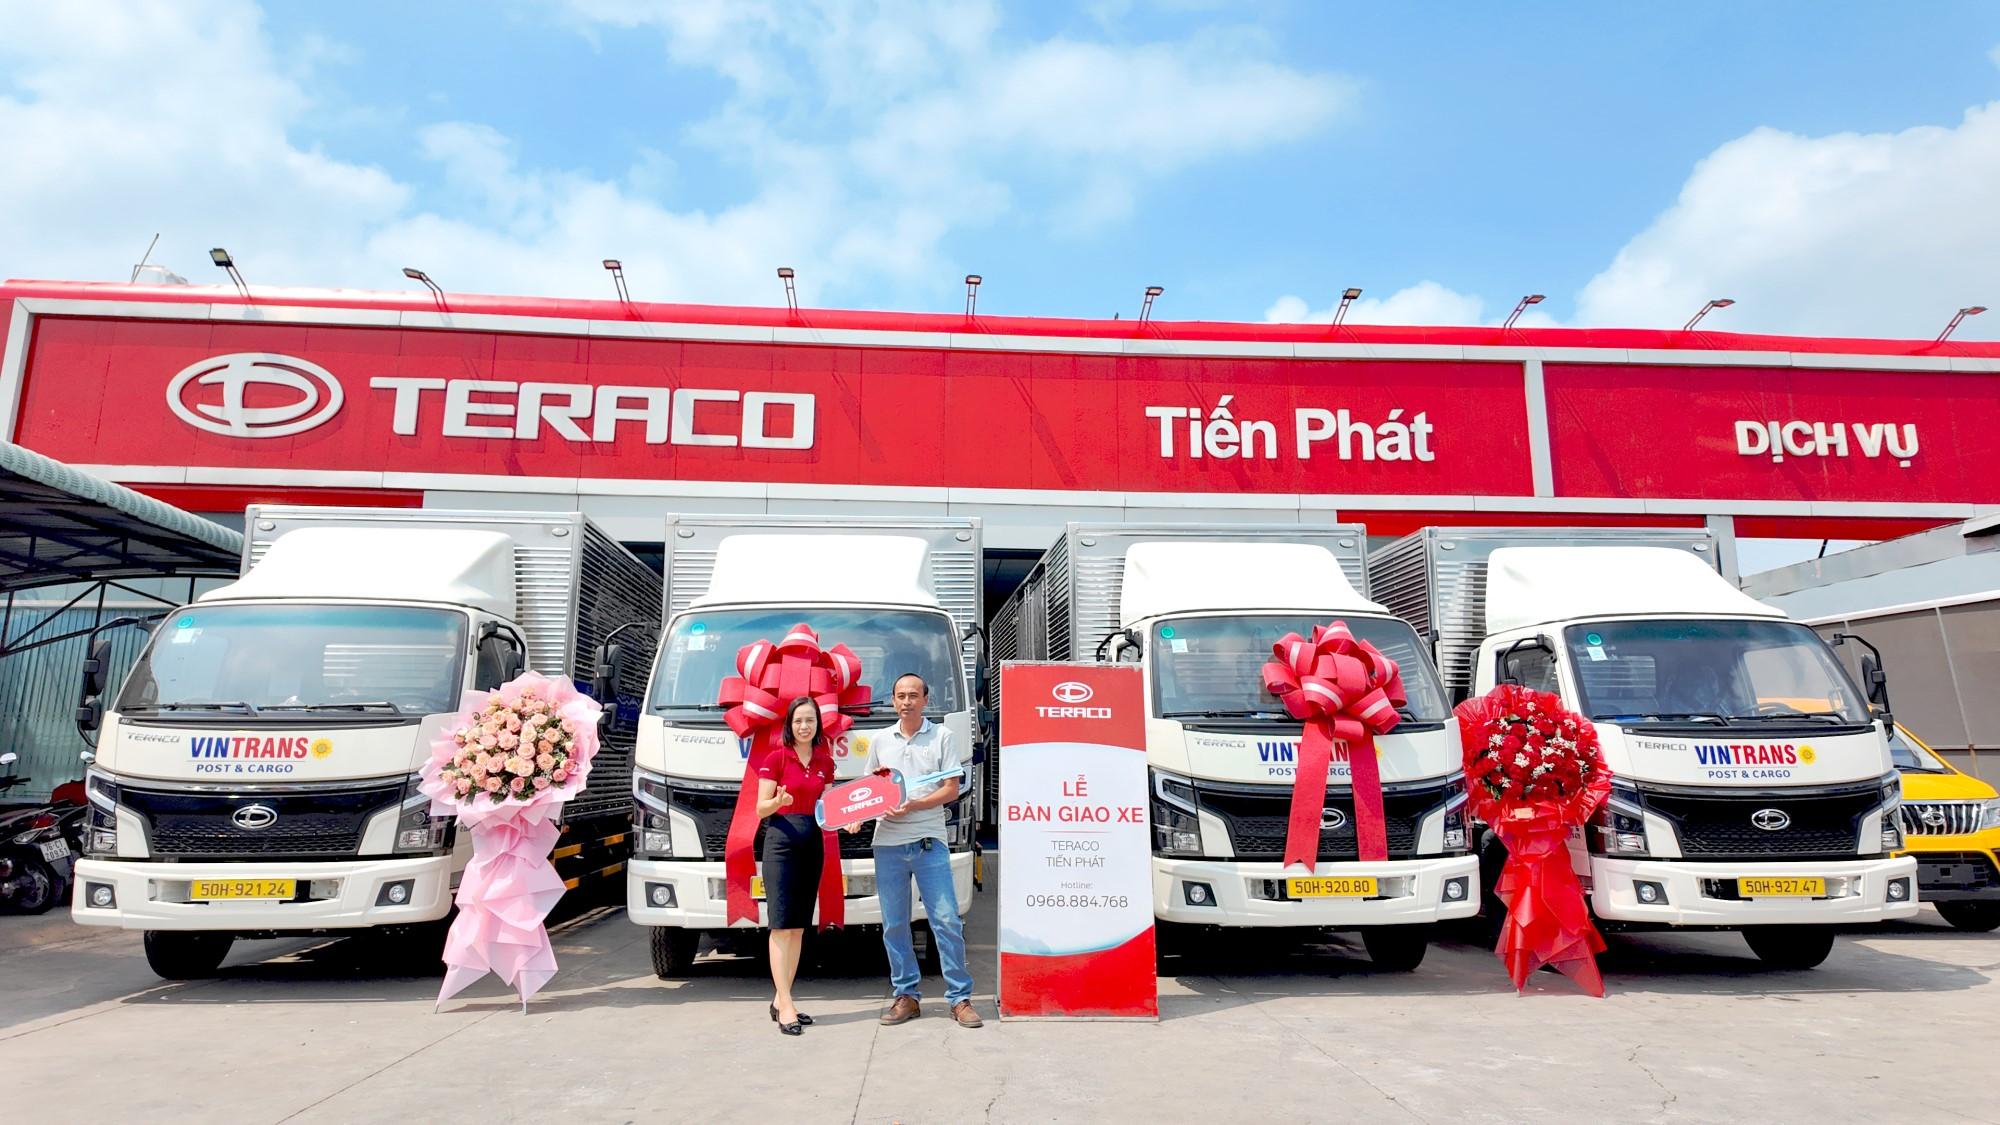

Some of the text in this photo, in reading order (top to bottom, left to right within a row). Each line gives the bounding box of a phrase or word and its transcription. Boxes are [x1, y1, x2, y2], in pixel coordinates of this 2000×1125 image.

[370, 377, 815, 449] TERACO
[1145, 394, 1435, 462] Tiến Phát
[1735, 420, 1919, 468] DỊCH VỤ
[1035, 706, 1112, 719] TERACO
[127, 731, 181, 744] TERACO
[672, 733, 726, 745] TERACO
[1194, 736, 1247, 749] TERACO
[190, 736, 309, 759] VINTRANS
[1635, 740, 1688, 751] TERACO
[1694, 744, 1797, 765] VINTRANS
[196, 763, 294, 773] POST & CARGO
[1327, 767, 1352, 776] RGO
[1708, 769, 1791, 779] POST & CARGO
[1063, 774, 1088, 797] LỄ
[840, 795, 884, 814] TERACO
[1008, 801, 1144, 823] BÀN GIAO XE
[1051, 840, 1100, 852] TERACO
[1045, 854, 1106, 868] TIẾN PHÁT
[200, 882, 286, 897] 50H-921.24
[1060, 881, 1094, 890] Hotline:
[1294, 880, 1370, 894] 50H-920.80
[1745, 880, 1818, 894] 50H-927.47
[1026, 894, 1129, 908] 0968.884.768
